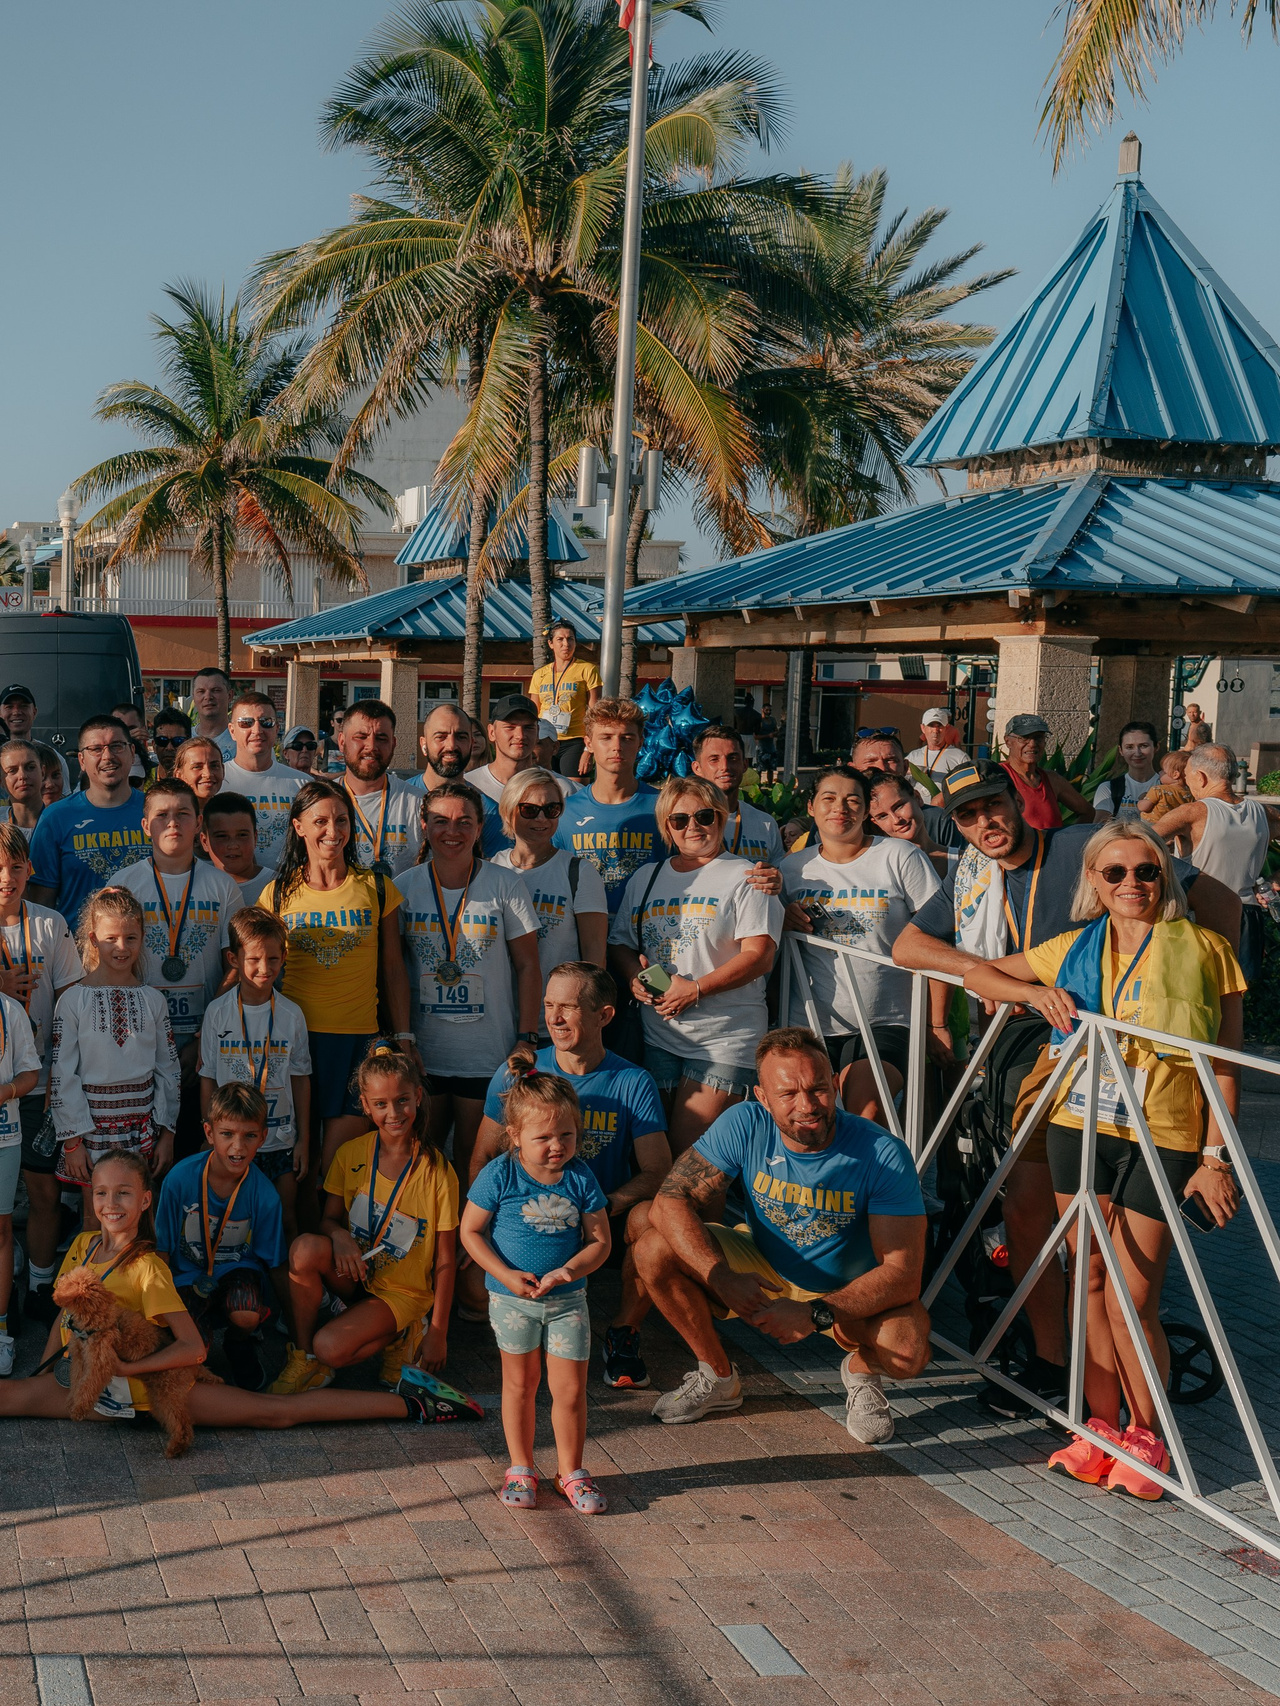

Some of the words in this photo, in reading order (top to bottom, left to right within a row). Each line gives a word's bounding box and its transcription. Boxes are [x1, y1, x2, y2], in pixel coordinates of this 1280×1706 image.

[540, 682, 578, 693] UKRINE
[572, 831, 654, 850] UKRAINE
[283, 908, 372, 929] UKRAINE
[436, 985, 469, 1003] 149
[167, 997, 189, 1016] 36
[753, 1171, 856, 1213] UKRAINE
